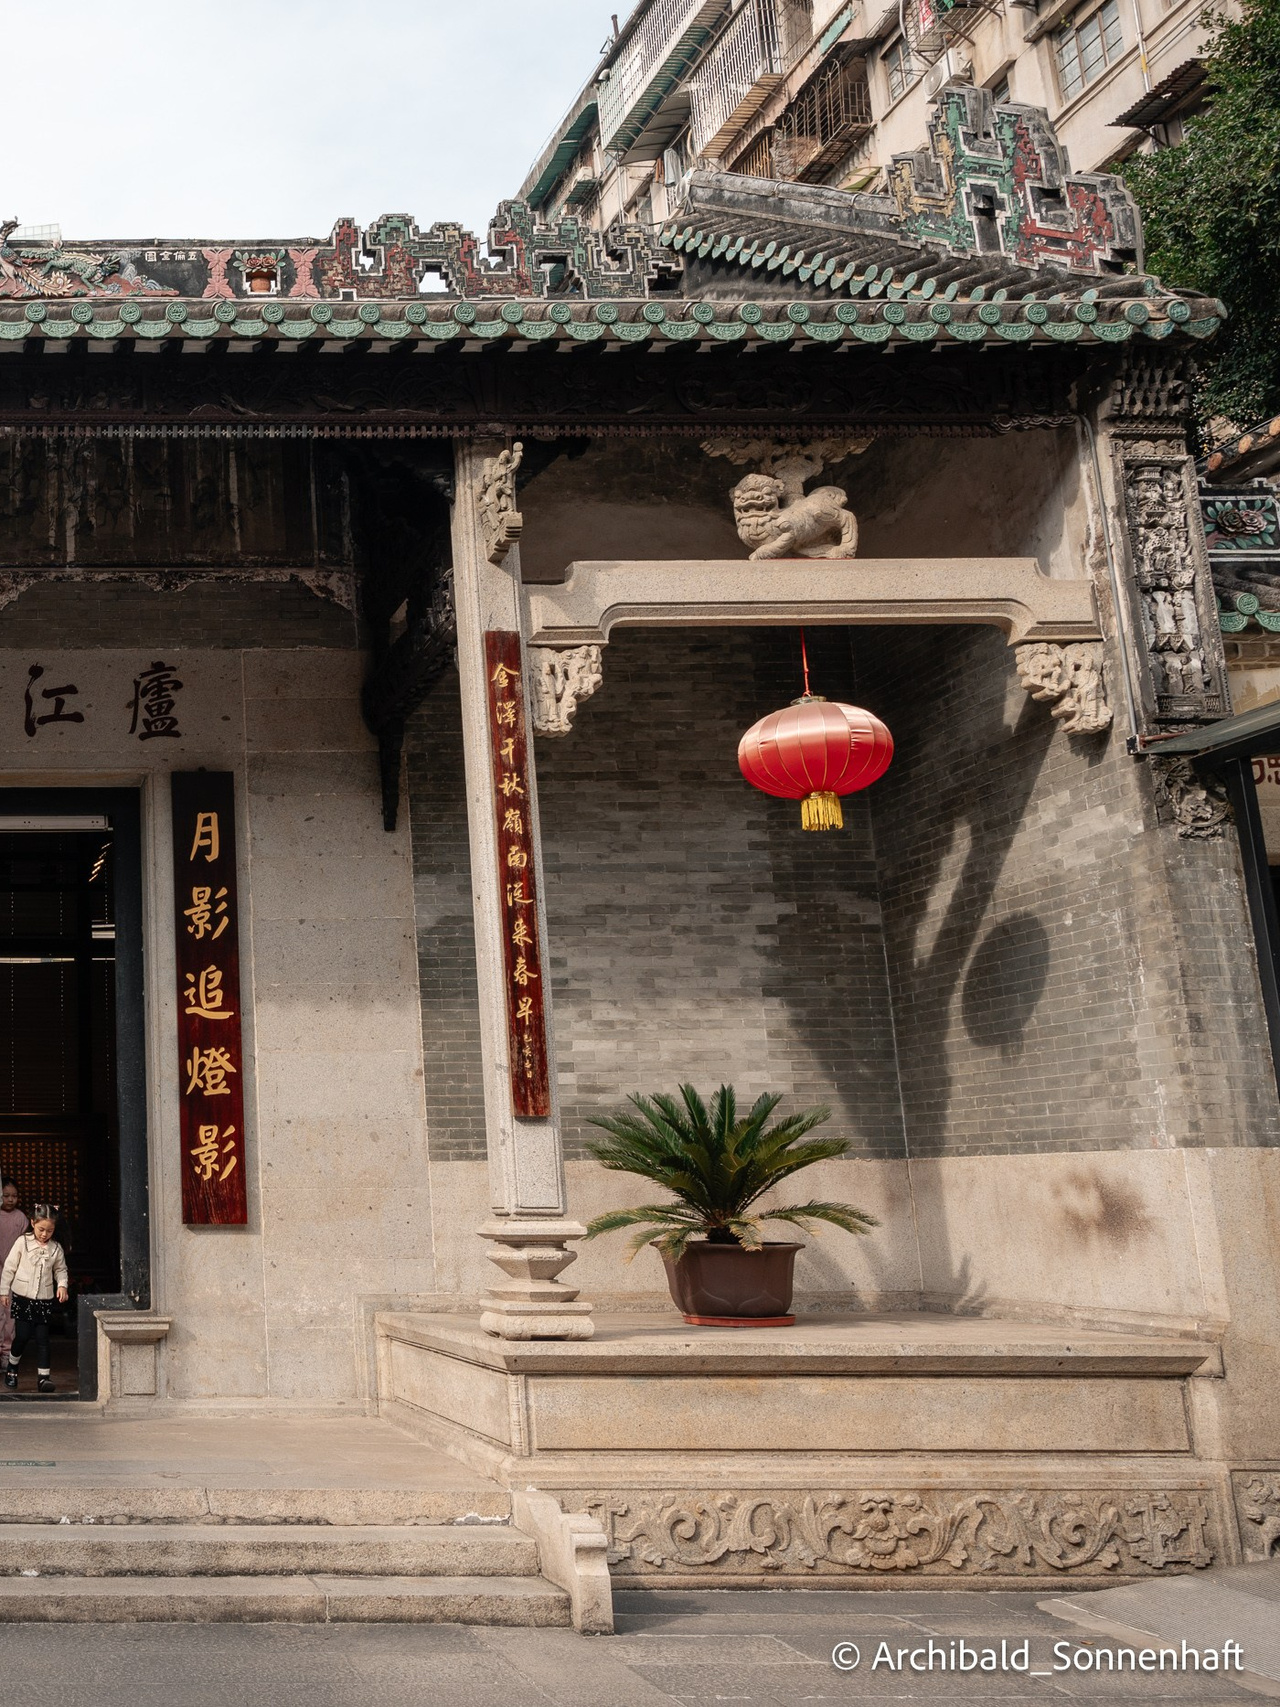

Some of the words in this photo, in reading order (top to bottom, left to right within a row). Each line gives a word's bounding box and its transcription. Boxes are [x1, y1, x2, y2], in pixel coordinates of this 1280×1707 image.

[182, 811, 238, 1183] 月影追燈影
